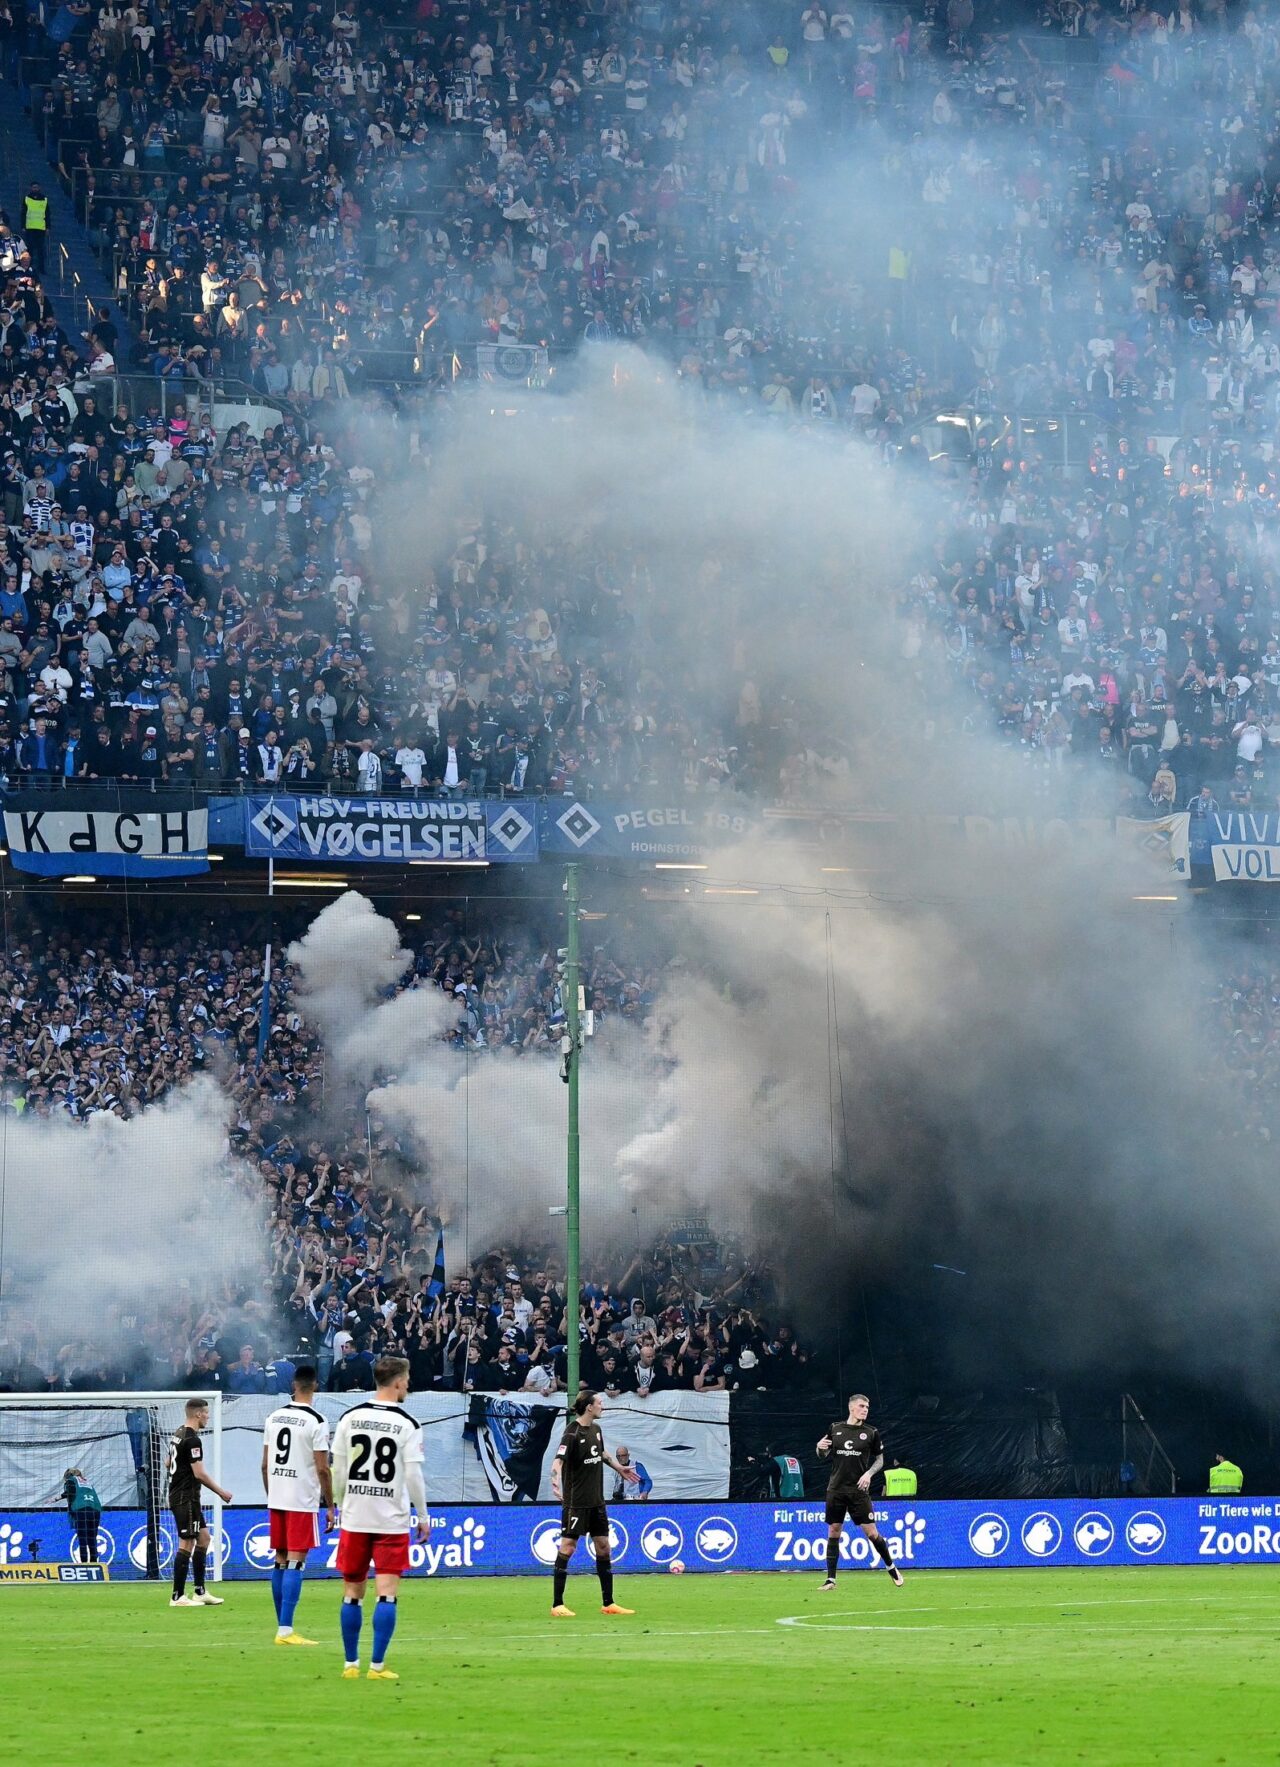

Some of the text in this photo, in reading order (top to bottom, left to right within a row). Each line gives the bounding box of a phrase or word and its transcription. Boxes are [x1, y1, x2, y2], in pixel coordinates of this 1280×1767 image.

[300, 798, 482, 820] HSV-FREUNDE
[614, 808, 693, 832] PEGEL
[300, 823, 486, 858] VØGELSEN
[351, 1420, 391, 1432] HAMBURGER
[275, 1427, 291, 1465] 9
[349, 1434, 397, 1483] 28
[348, 1485, 394, 1497] MUHEIM
[774, 1510, 826, 1522] Für Tiere
[1199, 1504, 1217, 1517] Für
[1220, 1504, 1248, 1516] Tiere
[1251, 1504, 1272, 1516] wie
[571, 1517, 578, 1530] 7
